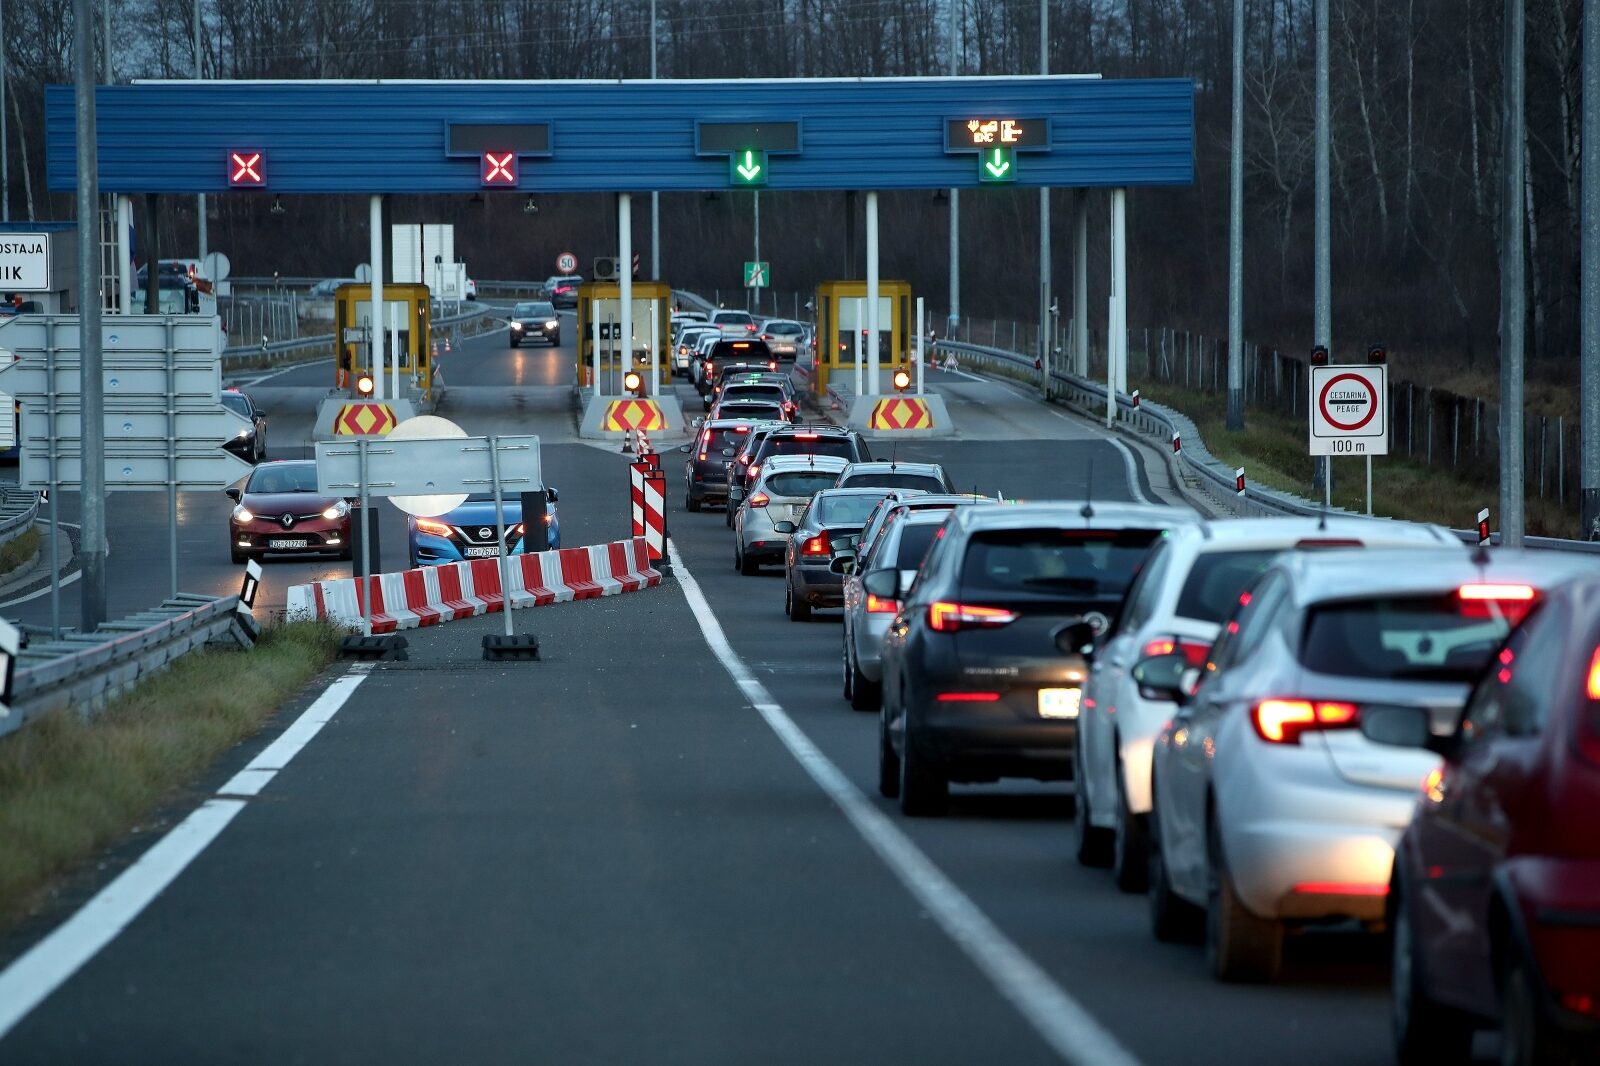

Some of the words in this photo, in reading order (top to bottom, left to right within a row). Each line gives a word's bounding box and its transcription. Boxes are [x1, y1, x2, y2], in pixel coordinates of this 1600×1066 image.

[561, 258, 573, 268] 50
[0, 266, 22, 280] IK
[1330, 391, 1367, 399] CESTARINA
[1332, 440, 1352, 452] 100
[1355, 442, 1365, 452] m
[468, 548, 479, 556] ZG
